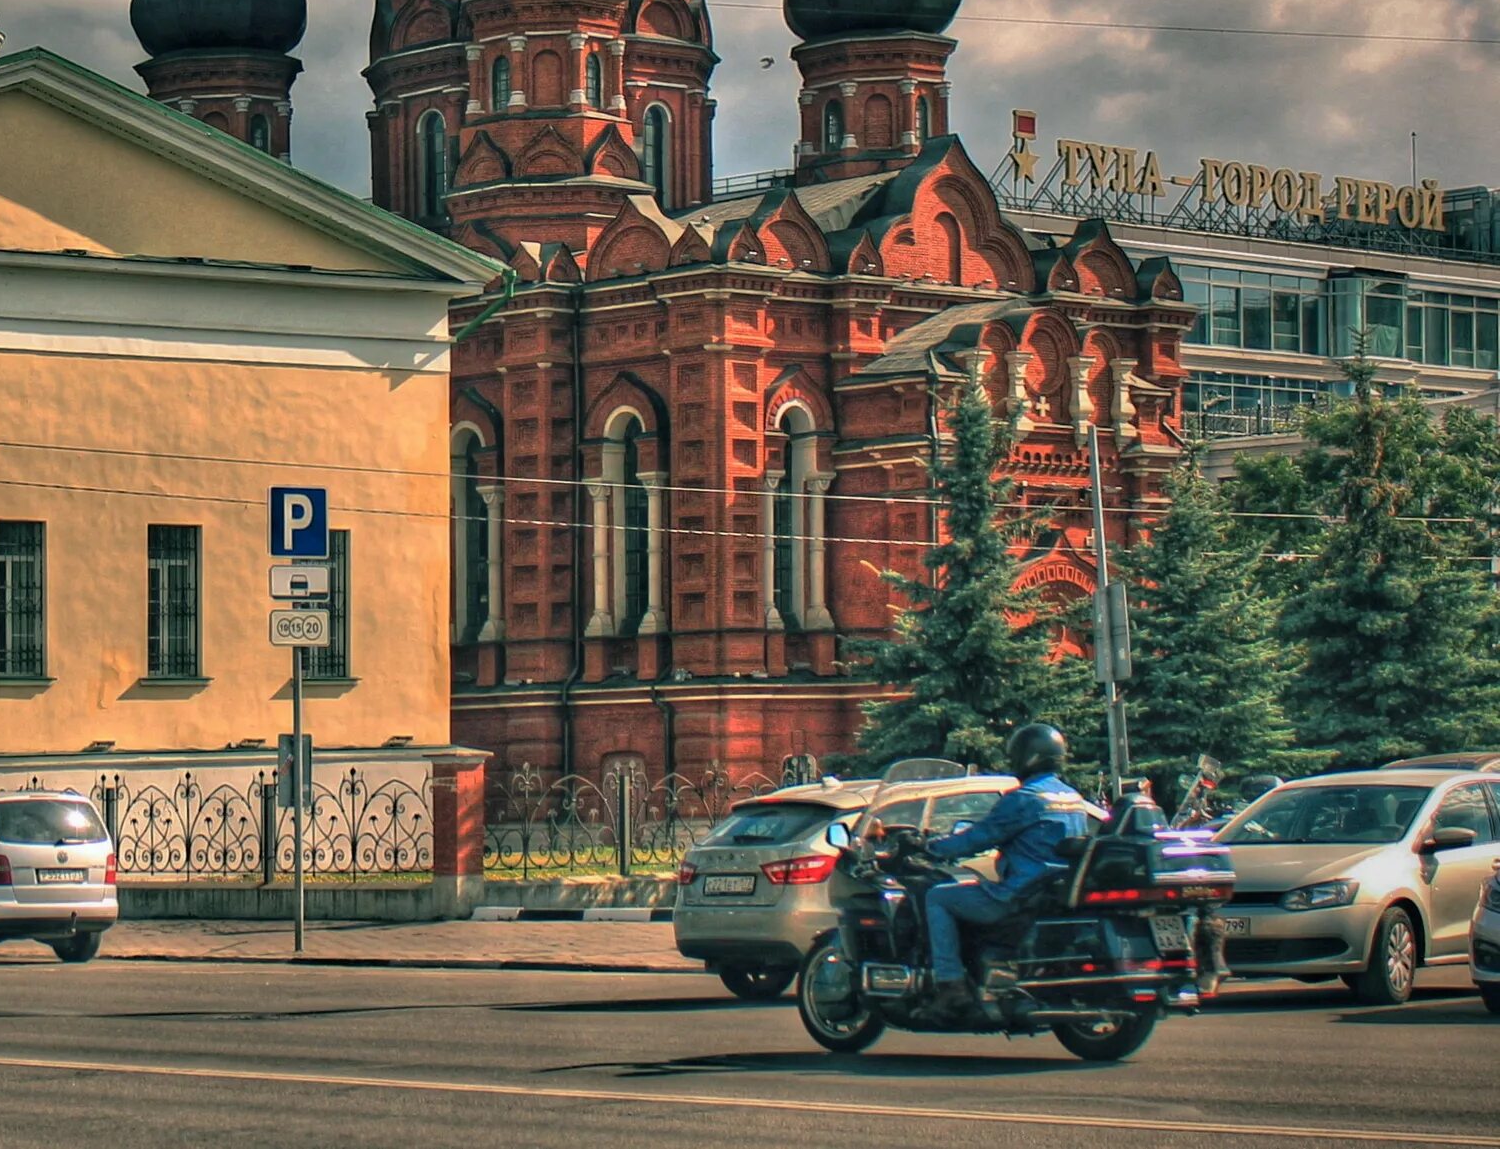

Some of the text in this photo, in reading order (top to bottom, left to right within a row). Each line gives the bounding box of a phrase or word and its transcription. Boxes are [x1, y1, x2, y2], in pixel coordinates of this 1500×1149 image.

[1057, 138, 1167, 197] ТУЛА
[283, 493, 314, 551] P
[291, 623, 302, 633] 15
[306, 622, 319, 634] 20
[1225, 920, 1245, 932] 799
